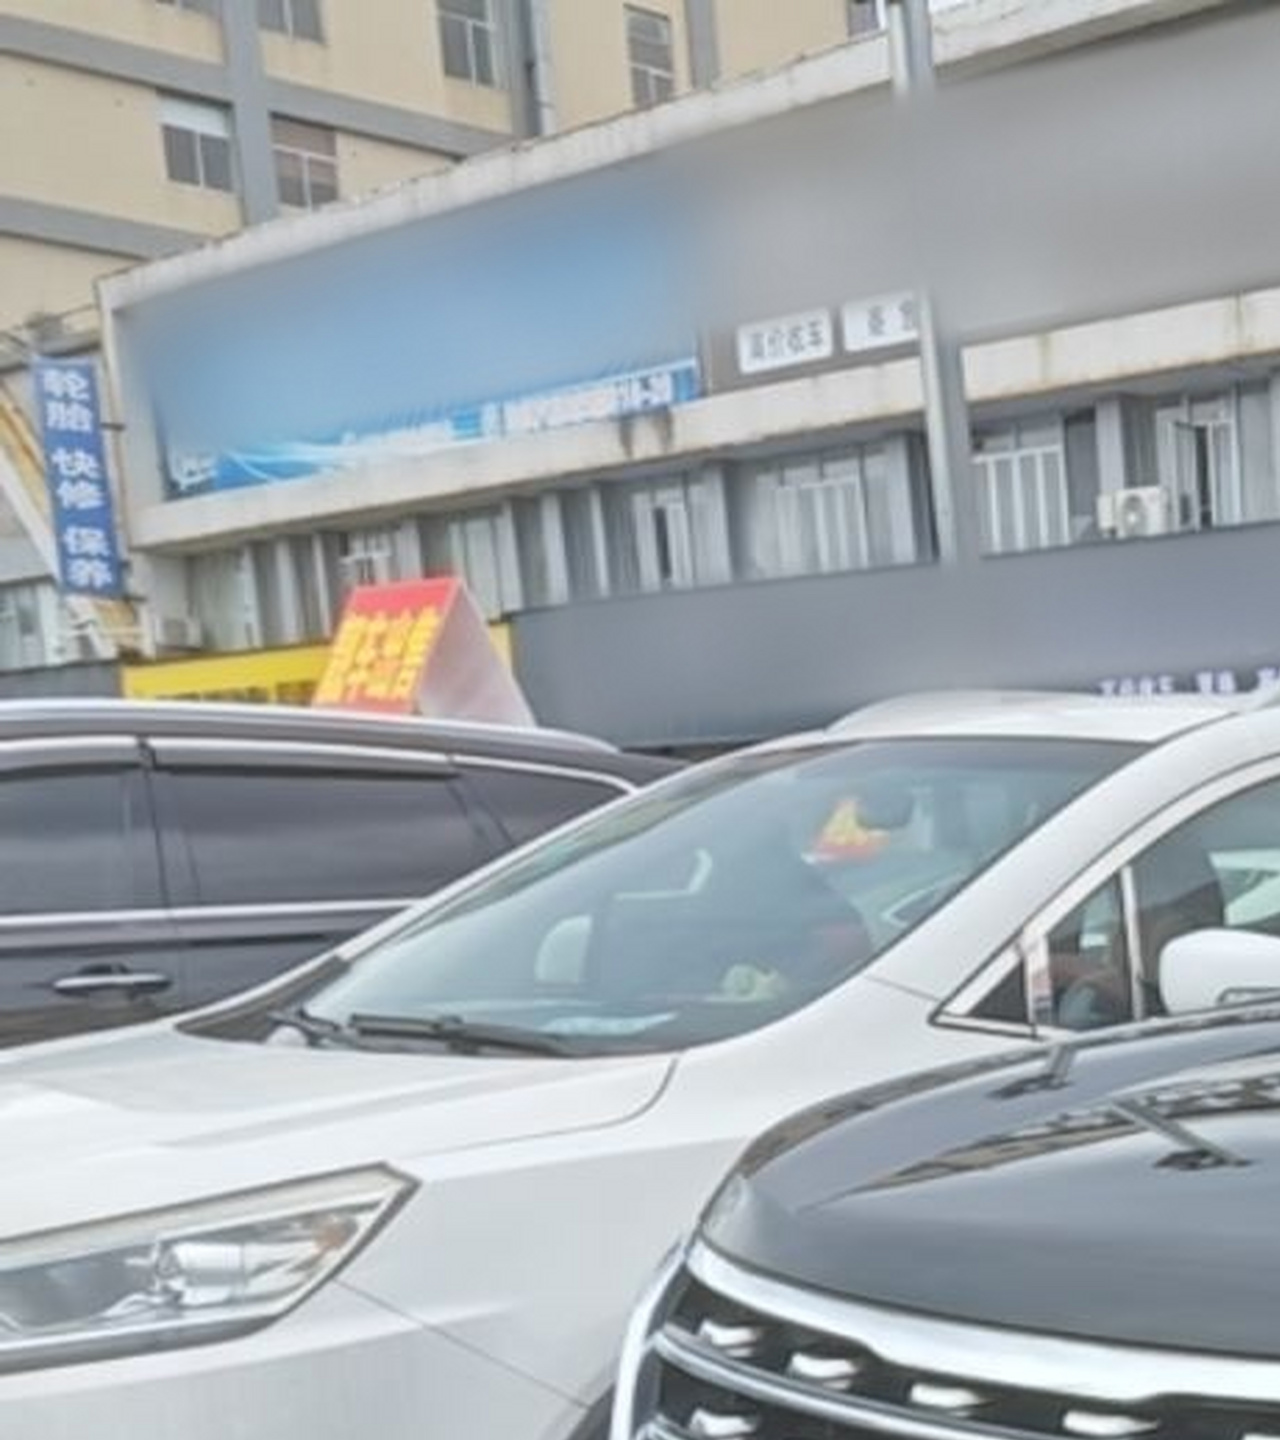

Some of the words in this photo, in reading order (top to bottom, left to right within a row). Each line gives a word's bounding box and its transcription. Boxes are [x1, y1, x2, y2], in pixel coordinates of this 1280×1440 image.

[42, 367, 93, 434] 轮胎
[51, 446, 104, 511] 快修
[62, 525, 114, 589] 保养
